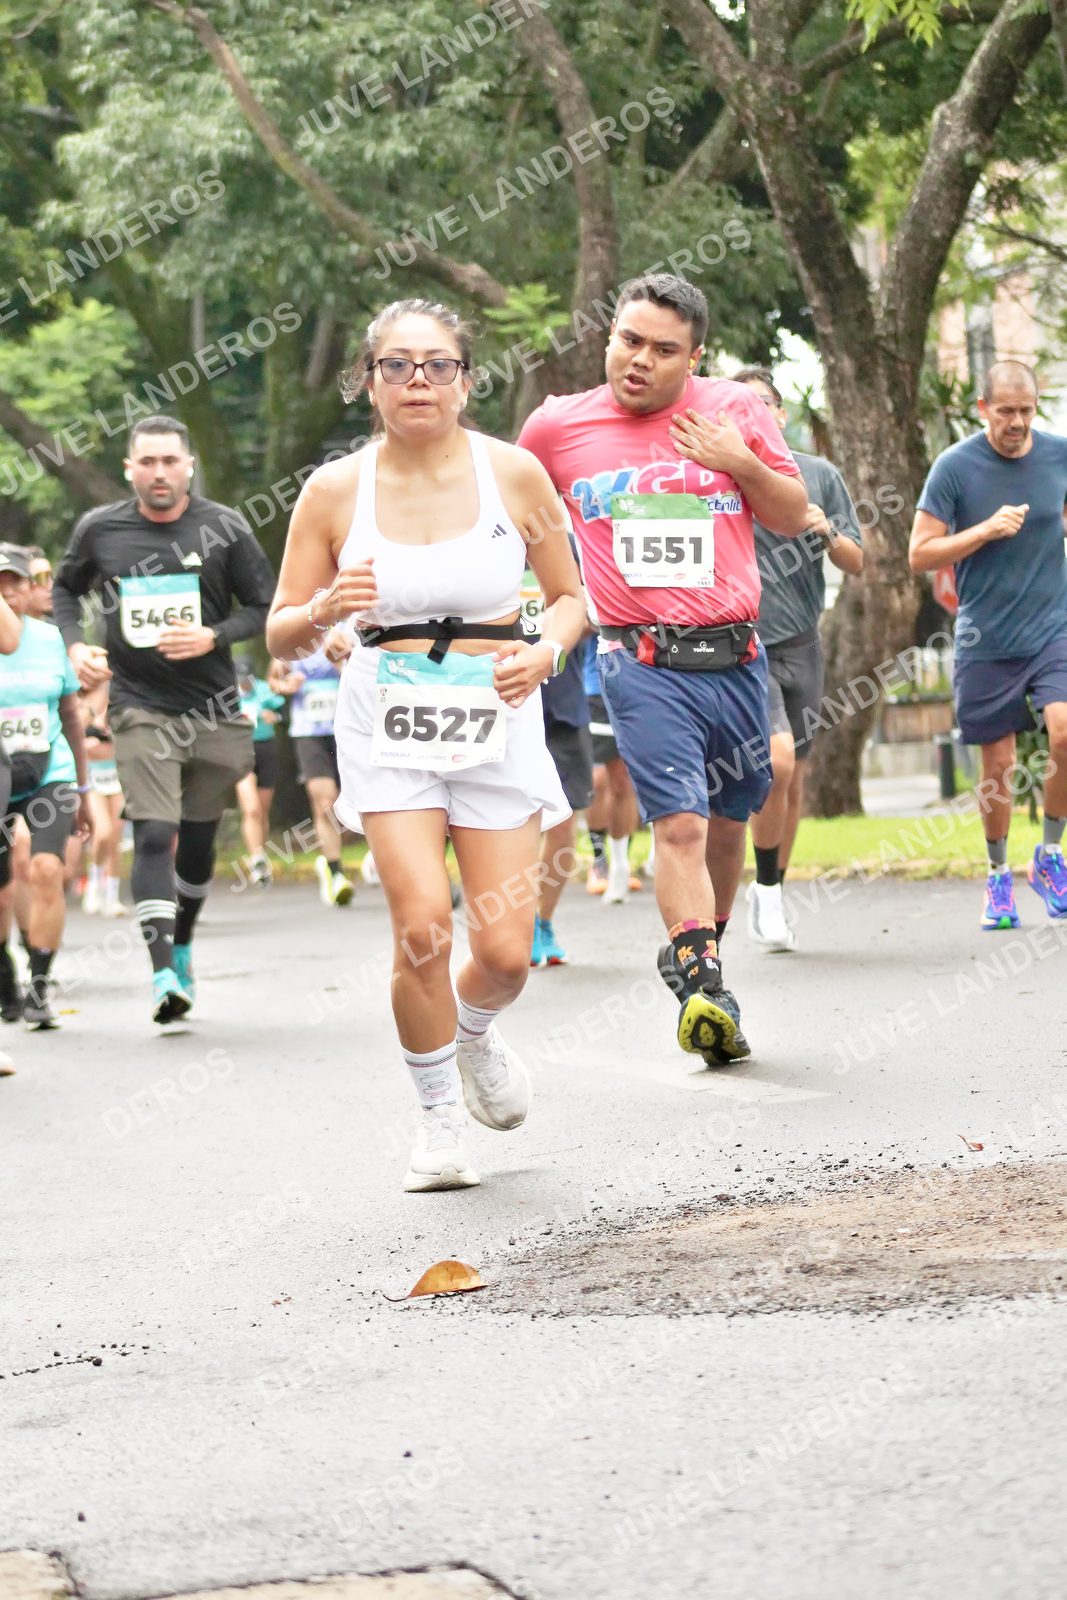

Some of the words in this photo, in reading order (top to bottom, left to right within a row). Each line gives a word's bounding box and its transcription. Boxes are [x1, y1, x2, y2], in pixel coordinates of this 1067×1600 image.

[620, 536, 703, 564] 1551
[131, 605, 195, 628] 5466
[384, 705, 498, 744] 6527
